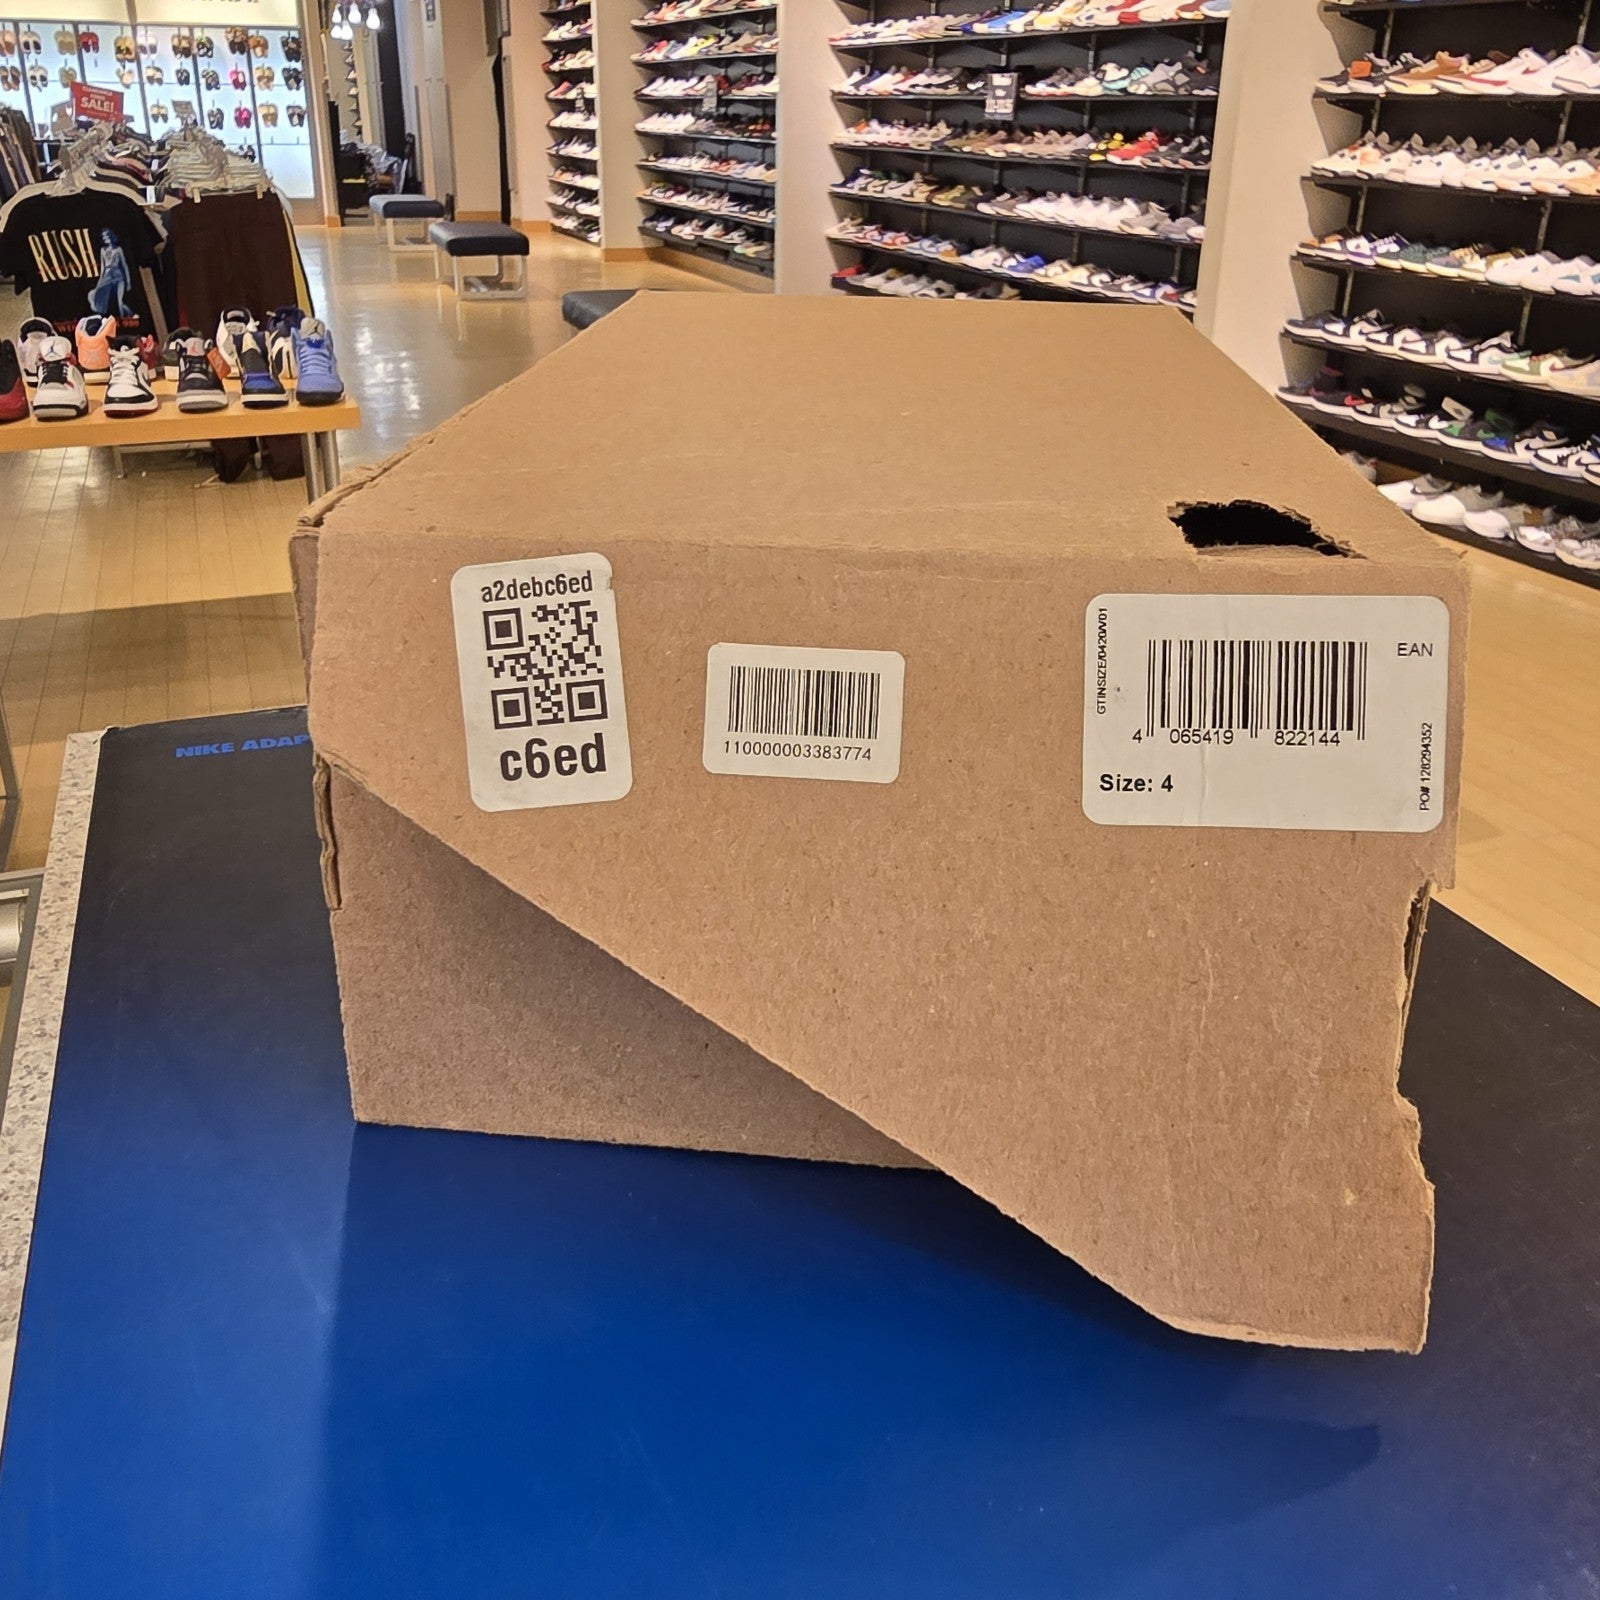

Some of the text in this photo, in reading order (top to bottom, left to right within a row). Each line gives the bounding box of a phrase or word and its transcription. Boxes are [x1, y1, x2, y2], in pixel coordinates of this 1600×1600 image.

[27, 228, 100, 283] RUSH
[480, 569, 594, 604] a2debc6ed
[1396, 642, 1434, 657] EAN
[1131, 728, 1342, 747] 4 065419 822144
[175, 742, 235, 758] NIKE
[499, 732, 607, 782] c6ed
[724, 740, 872, 761] 110000003383774
[1418, 721, 1433, 812] PO# 128294352
[1099, 773, 1174, 793] Size: 4
